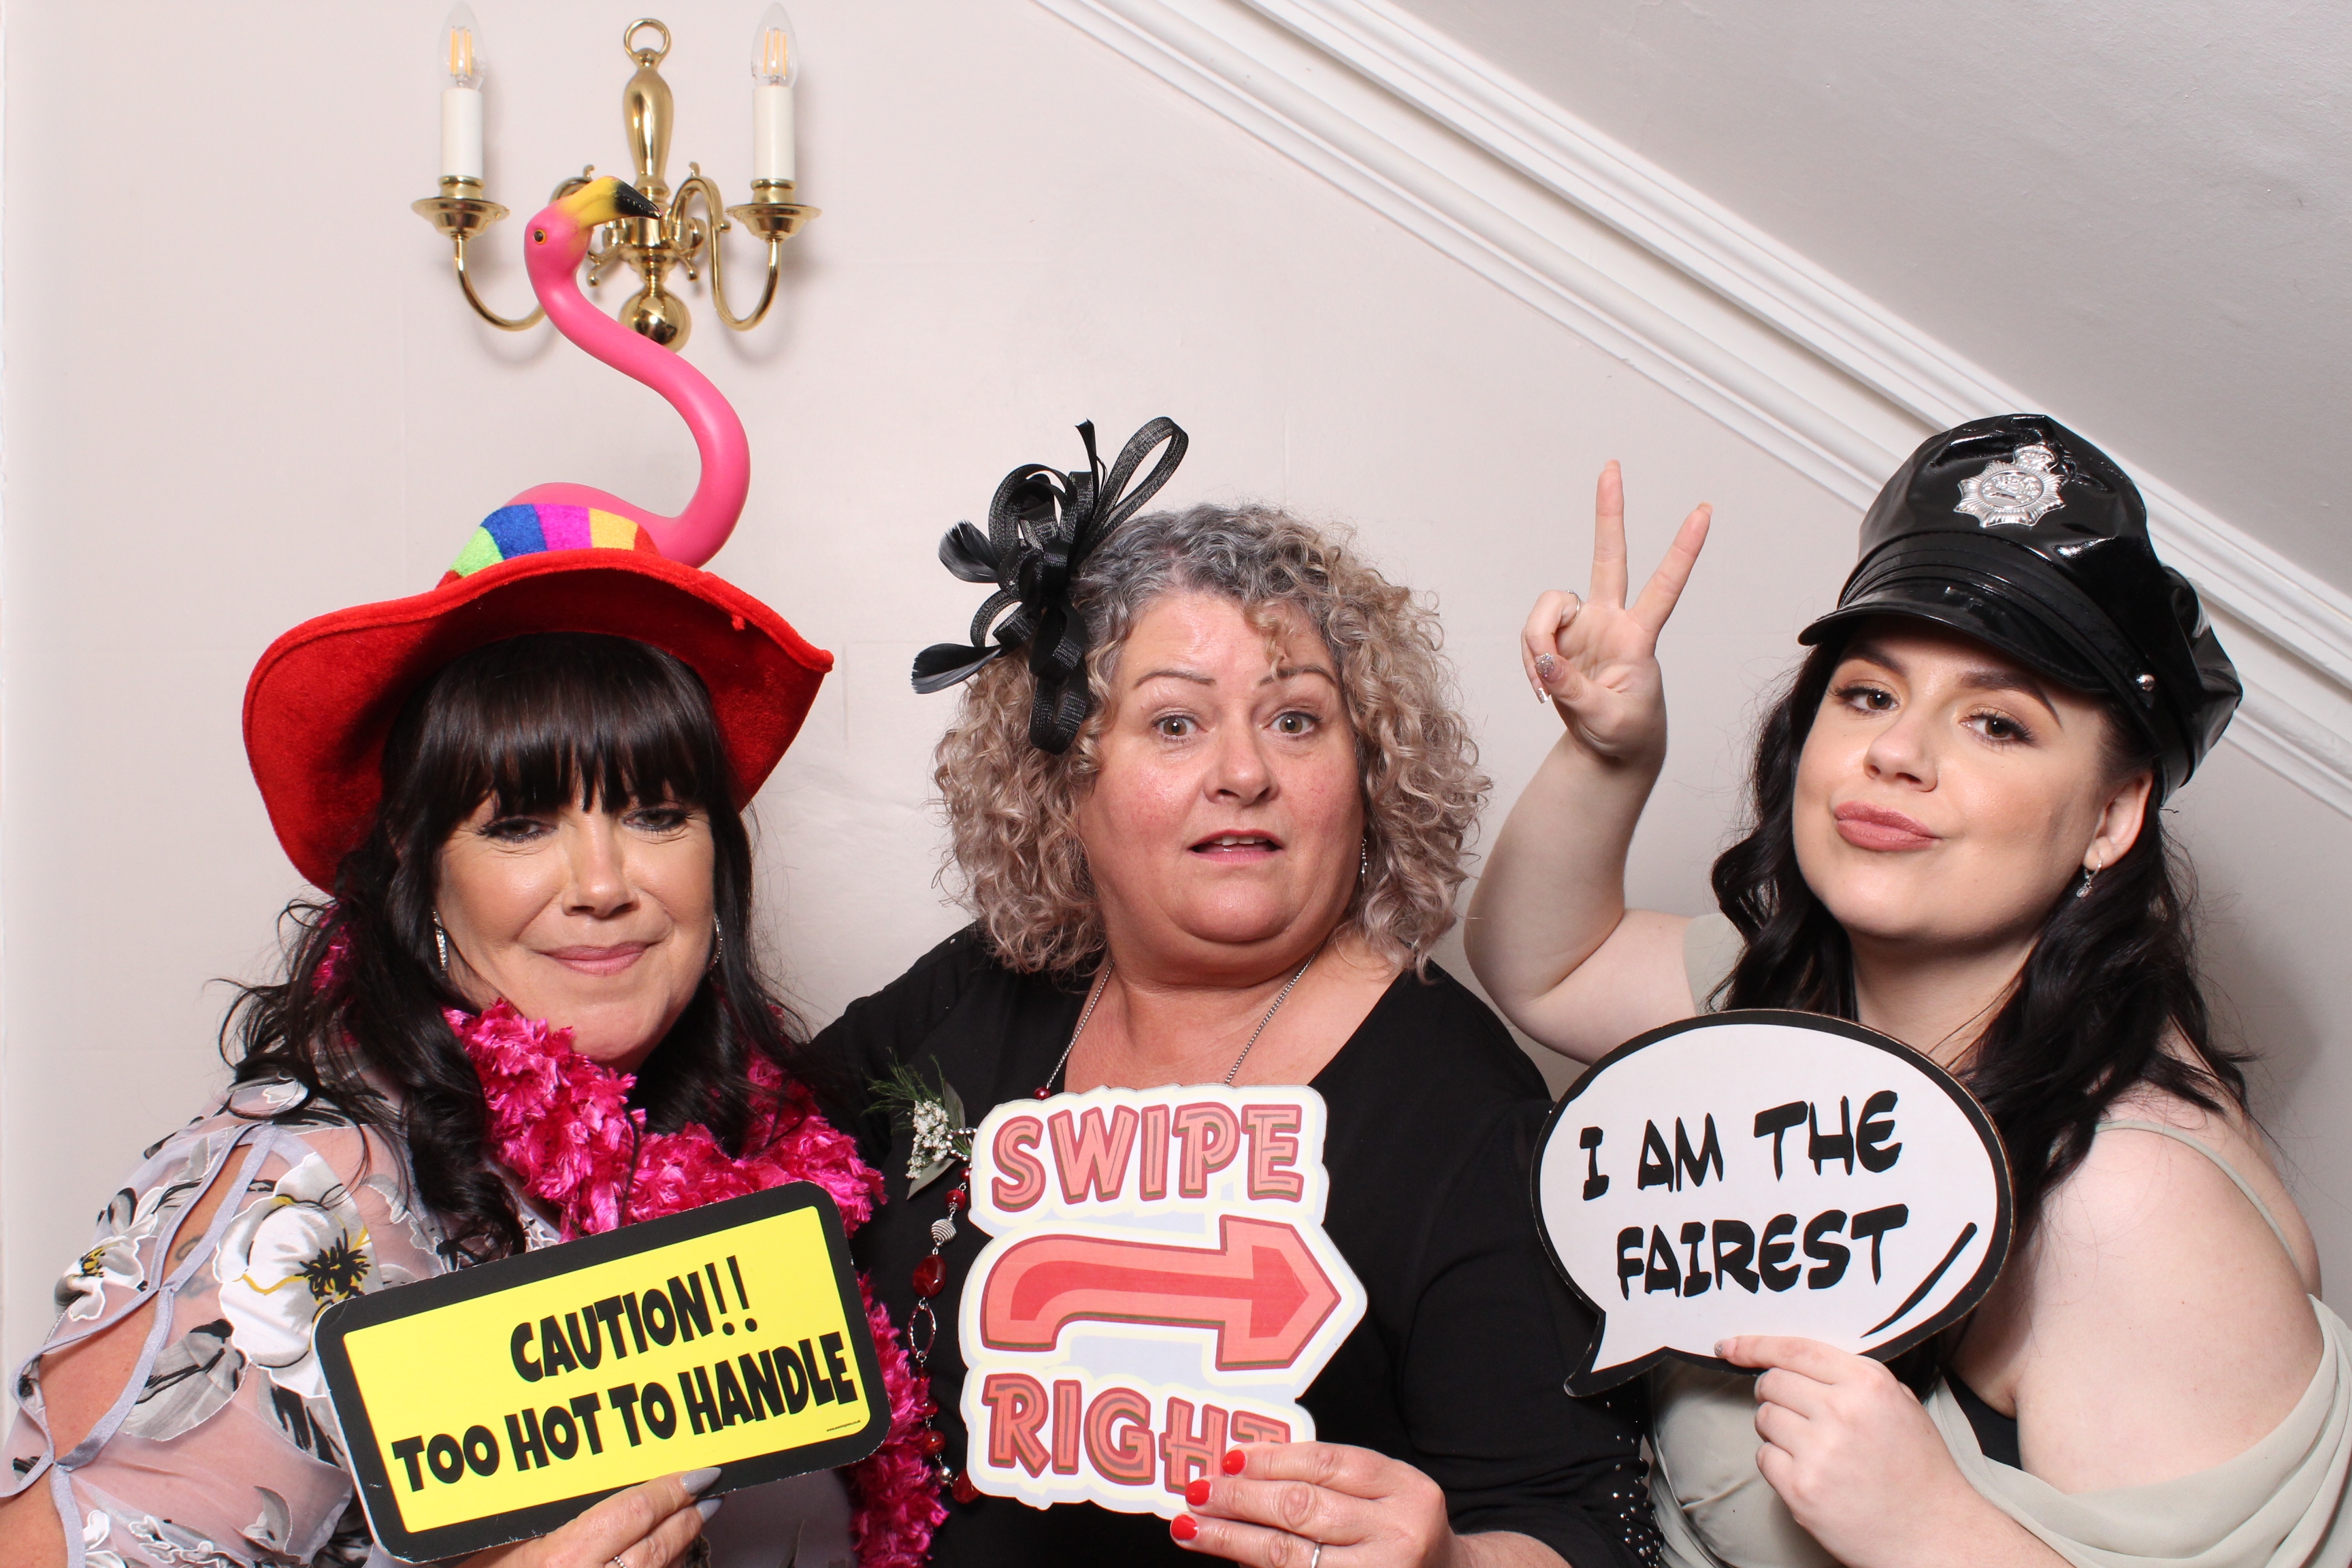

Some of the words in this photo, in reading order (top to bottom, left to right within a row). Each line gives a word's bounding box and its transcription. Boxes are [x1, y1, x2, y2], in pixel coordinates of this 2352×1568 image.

[991, 1101, 1304, 1212] SWIPE
[1579, 1126, 1610, 1201] I
[1637, 1113, 1723, 1193] AM
[1754, 1090, 1902, 1181] THE
[1616, 1203, 1909, 1301] FAIREST
[510, 1256, 758, 1382] CAUTION!!
[391, 1426, 500, 1492] TOO
[504, 1393, 603, 1471] HOT
[607, 1382, 676, 1447] TO
[677, 1331, 858, 1435] HANDLE
